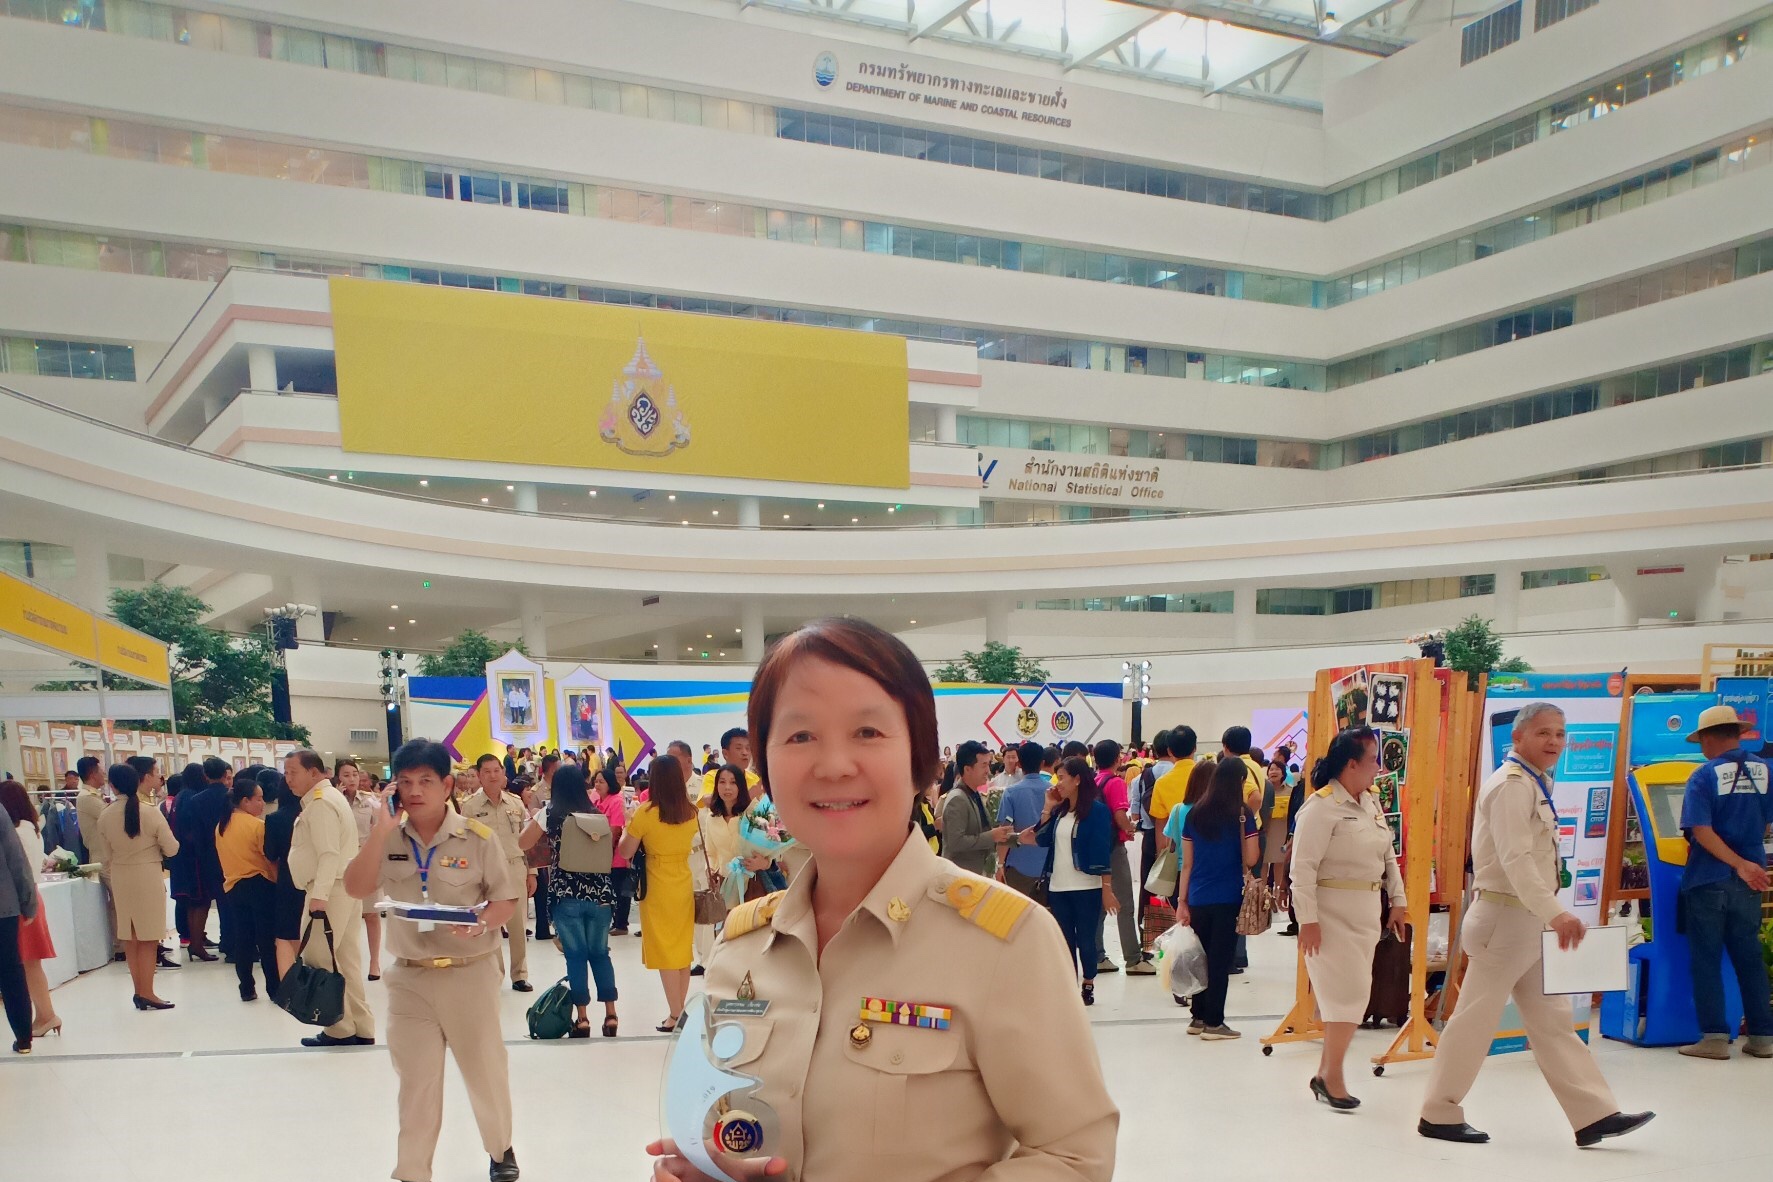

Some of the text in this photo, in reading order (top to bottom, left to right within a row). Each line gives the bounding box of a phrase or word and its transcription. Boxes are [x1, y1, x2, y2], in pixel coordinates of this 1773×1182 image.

[858, 60, 1068, 110] กรมทรัพยากรทางทะเลและชายฝั่ง
[845, 81, 1072, 128] DEPARTMENT OF MARINE AND COASTAL RESOURCES
[1024, 456, 1160, 483] สำนักงานสถิติแห่งชาติ
[1008, 478, 1164, 499] National Statistical Office
